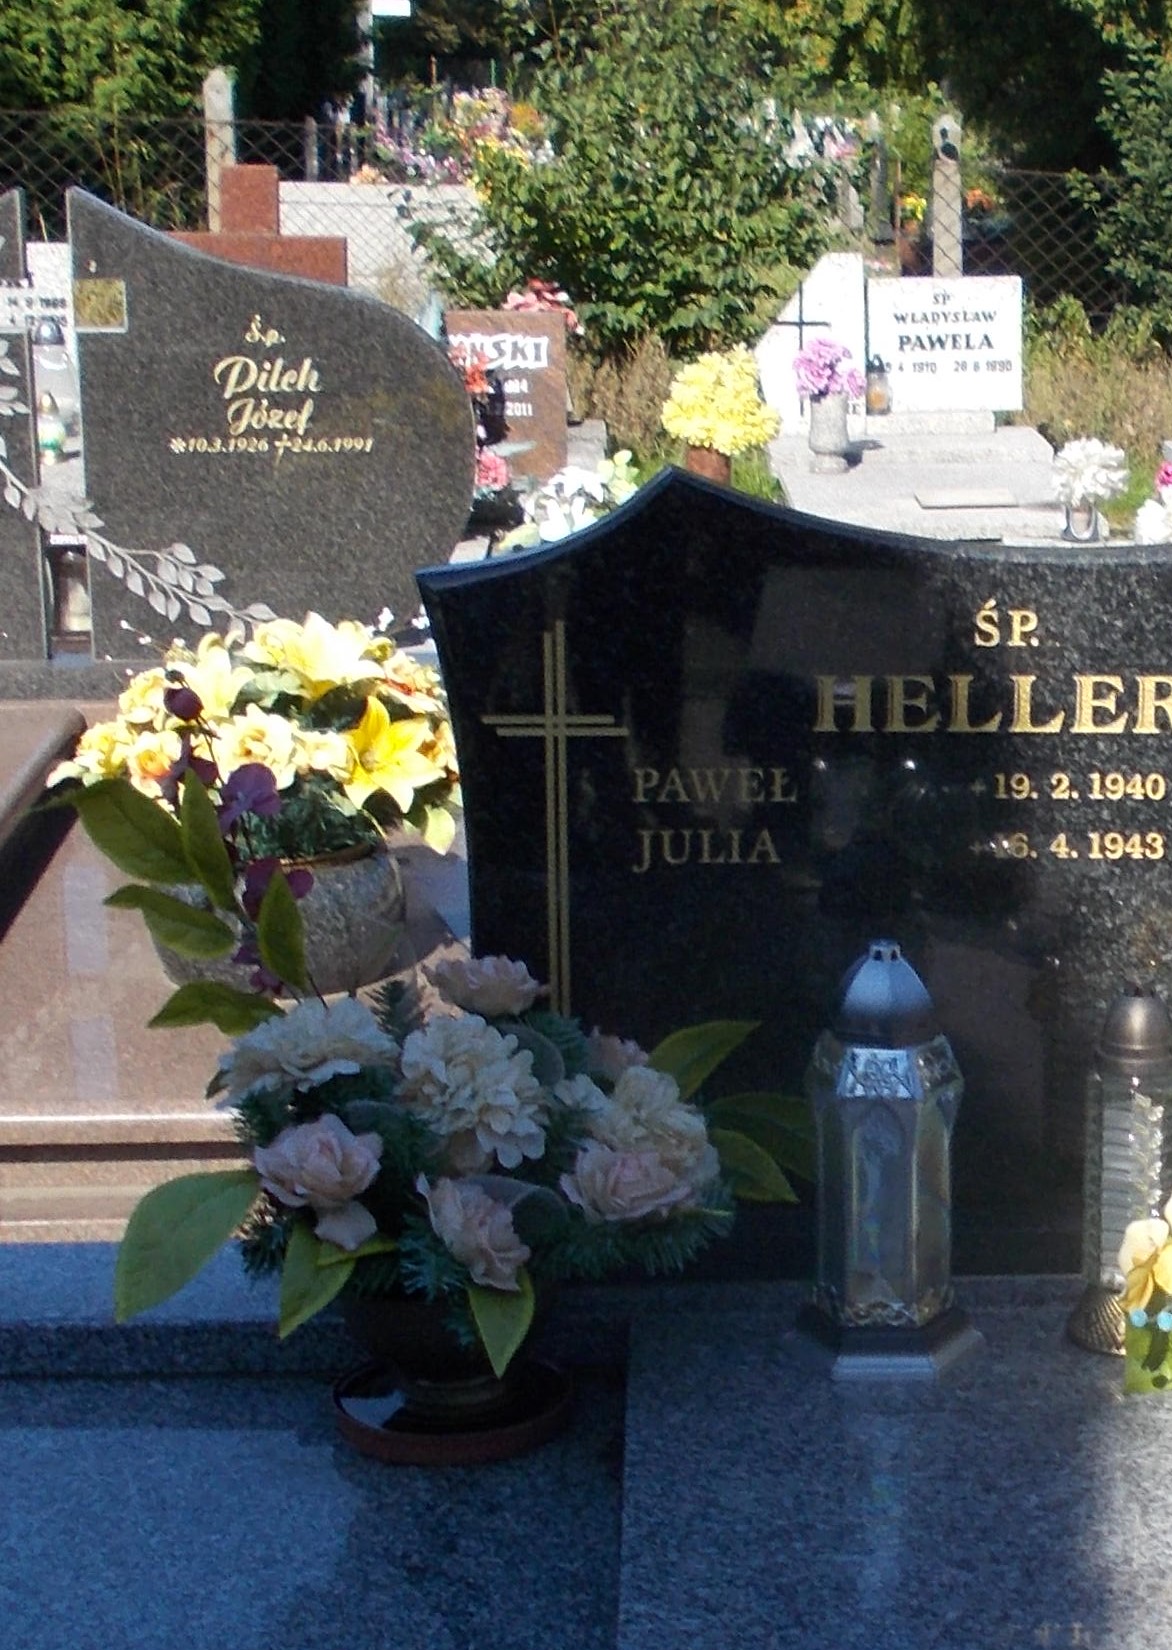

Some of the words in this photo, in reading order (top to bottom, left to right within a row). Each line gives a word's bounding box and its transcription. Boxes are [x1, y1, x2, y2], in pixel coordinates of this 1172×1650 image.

[898, 333, 994, 351] PAWELA
[214, 356, 322, 399] Pilch
[227, 398, 314, 436] Józef
[633, 767, 797, 803] PAWEŁ
[1088, 772, 1166, 800] 1940
[633, 828, 781, 873] JULIA
[1088, 832, 1165, 860] 1943
